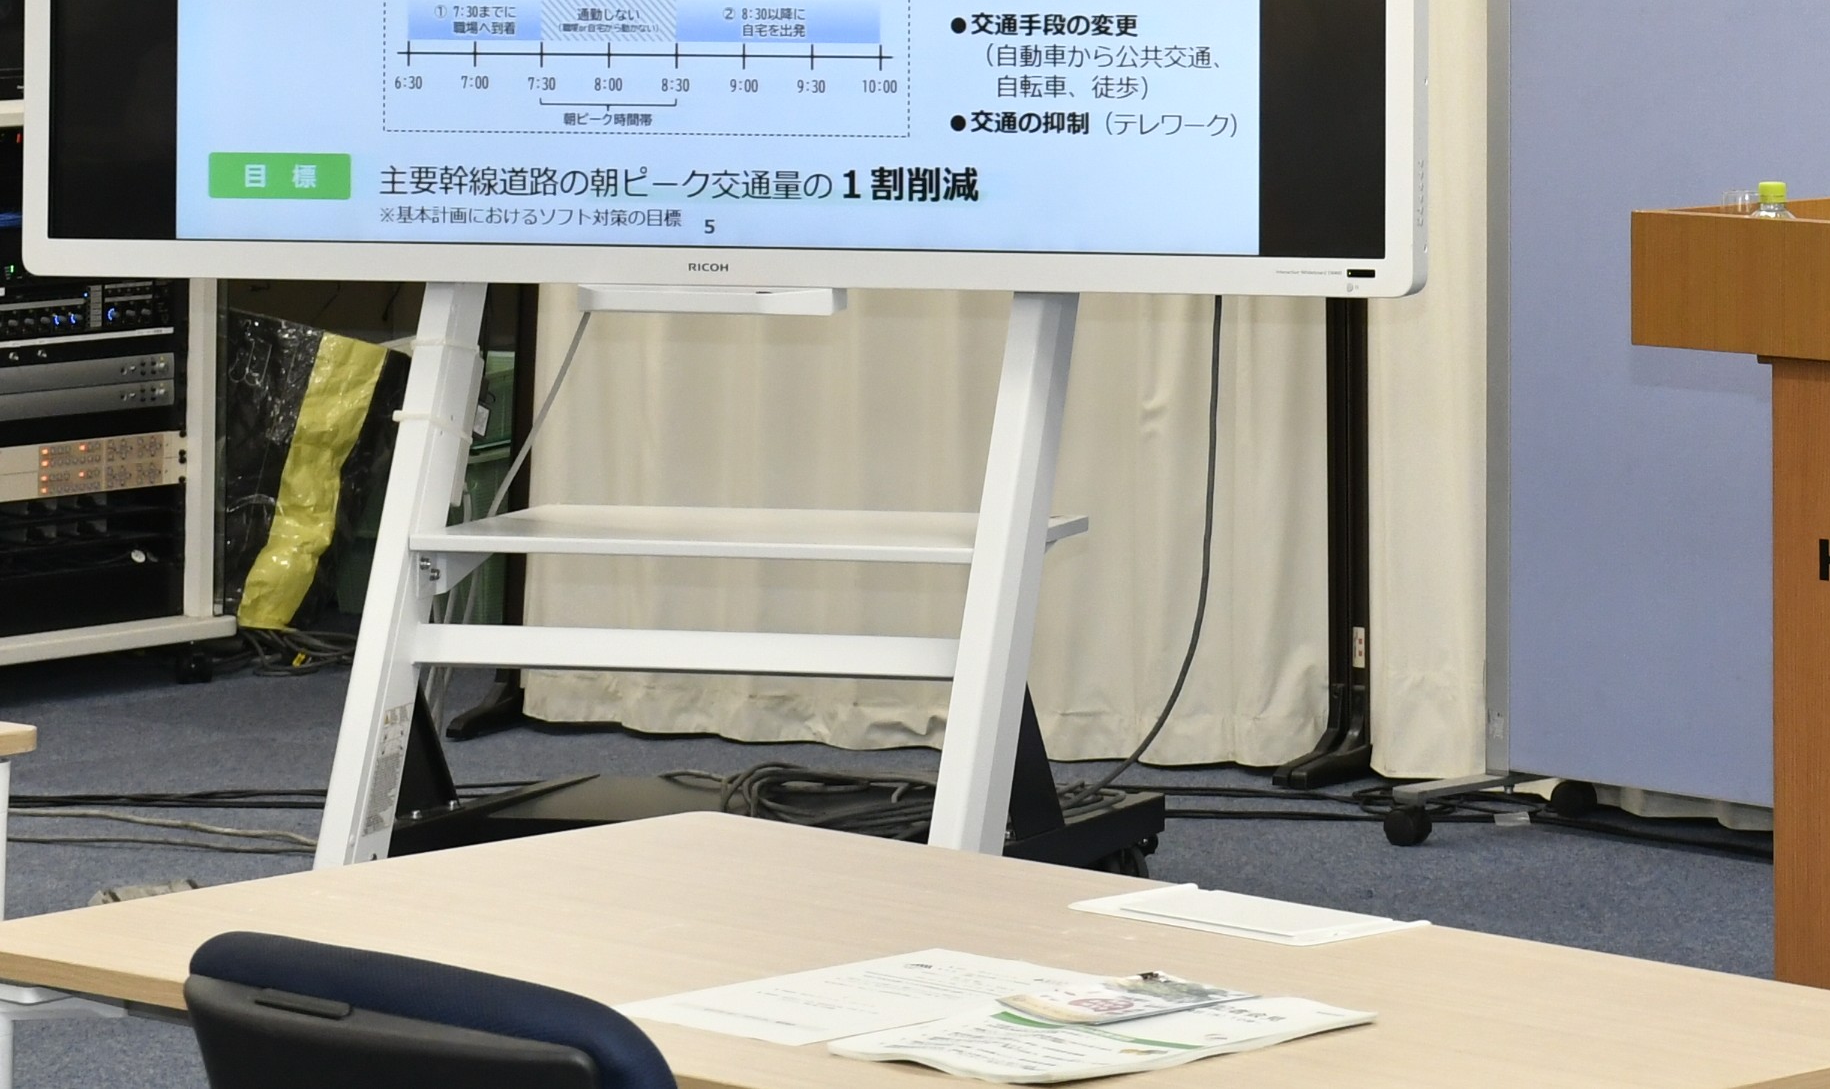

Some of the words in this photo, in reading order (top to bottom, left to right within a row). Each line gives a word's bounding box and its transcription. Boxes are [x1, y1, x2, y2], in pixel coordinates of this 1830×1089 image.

[742, 8, 805, 20] 8:30以降に
[972, 13, 1137, 37] 交通手段の変更
[453, 21, 516, 36] 職場へ到着
[743, 24, 806, 38] 自宅を出発
[987, 43, 1219, 68] （自動車から公共交通、
[395, 76, 422, 89] 6:30
[461, 76, 489, 89] 7:00
[528, 77, 556, 90] 7:30
[595, 78, 622, 91] 8:00
[662, 78, 690, 92] 8:30
[730, 79, 758, 92] 9:00
[797, 80, 825, 93] 9:30
[863, 80, 897, 93] 10:00
[998, 75, 1147, 100] 自転車、徒歩）
[564, 113, 652, 126] 朝ピーク時間帯
[971, 110, 1236, 137] 交通の抑制（テレワーク）
[245, 164, 316, 188] 目標
[380, 166, 978, 202] 主要幹線道路の朝ピーク交通量の1割削減
[381, 206, 681, 227] ※基本計画におけるソフト対策の目標
[705, 220, 715, 234] 5
[689, 263, 728, 271] RICOH
